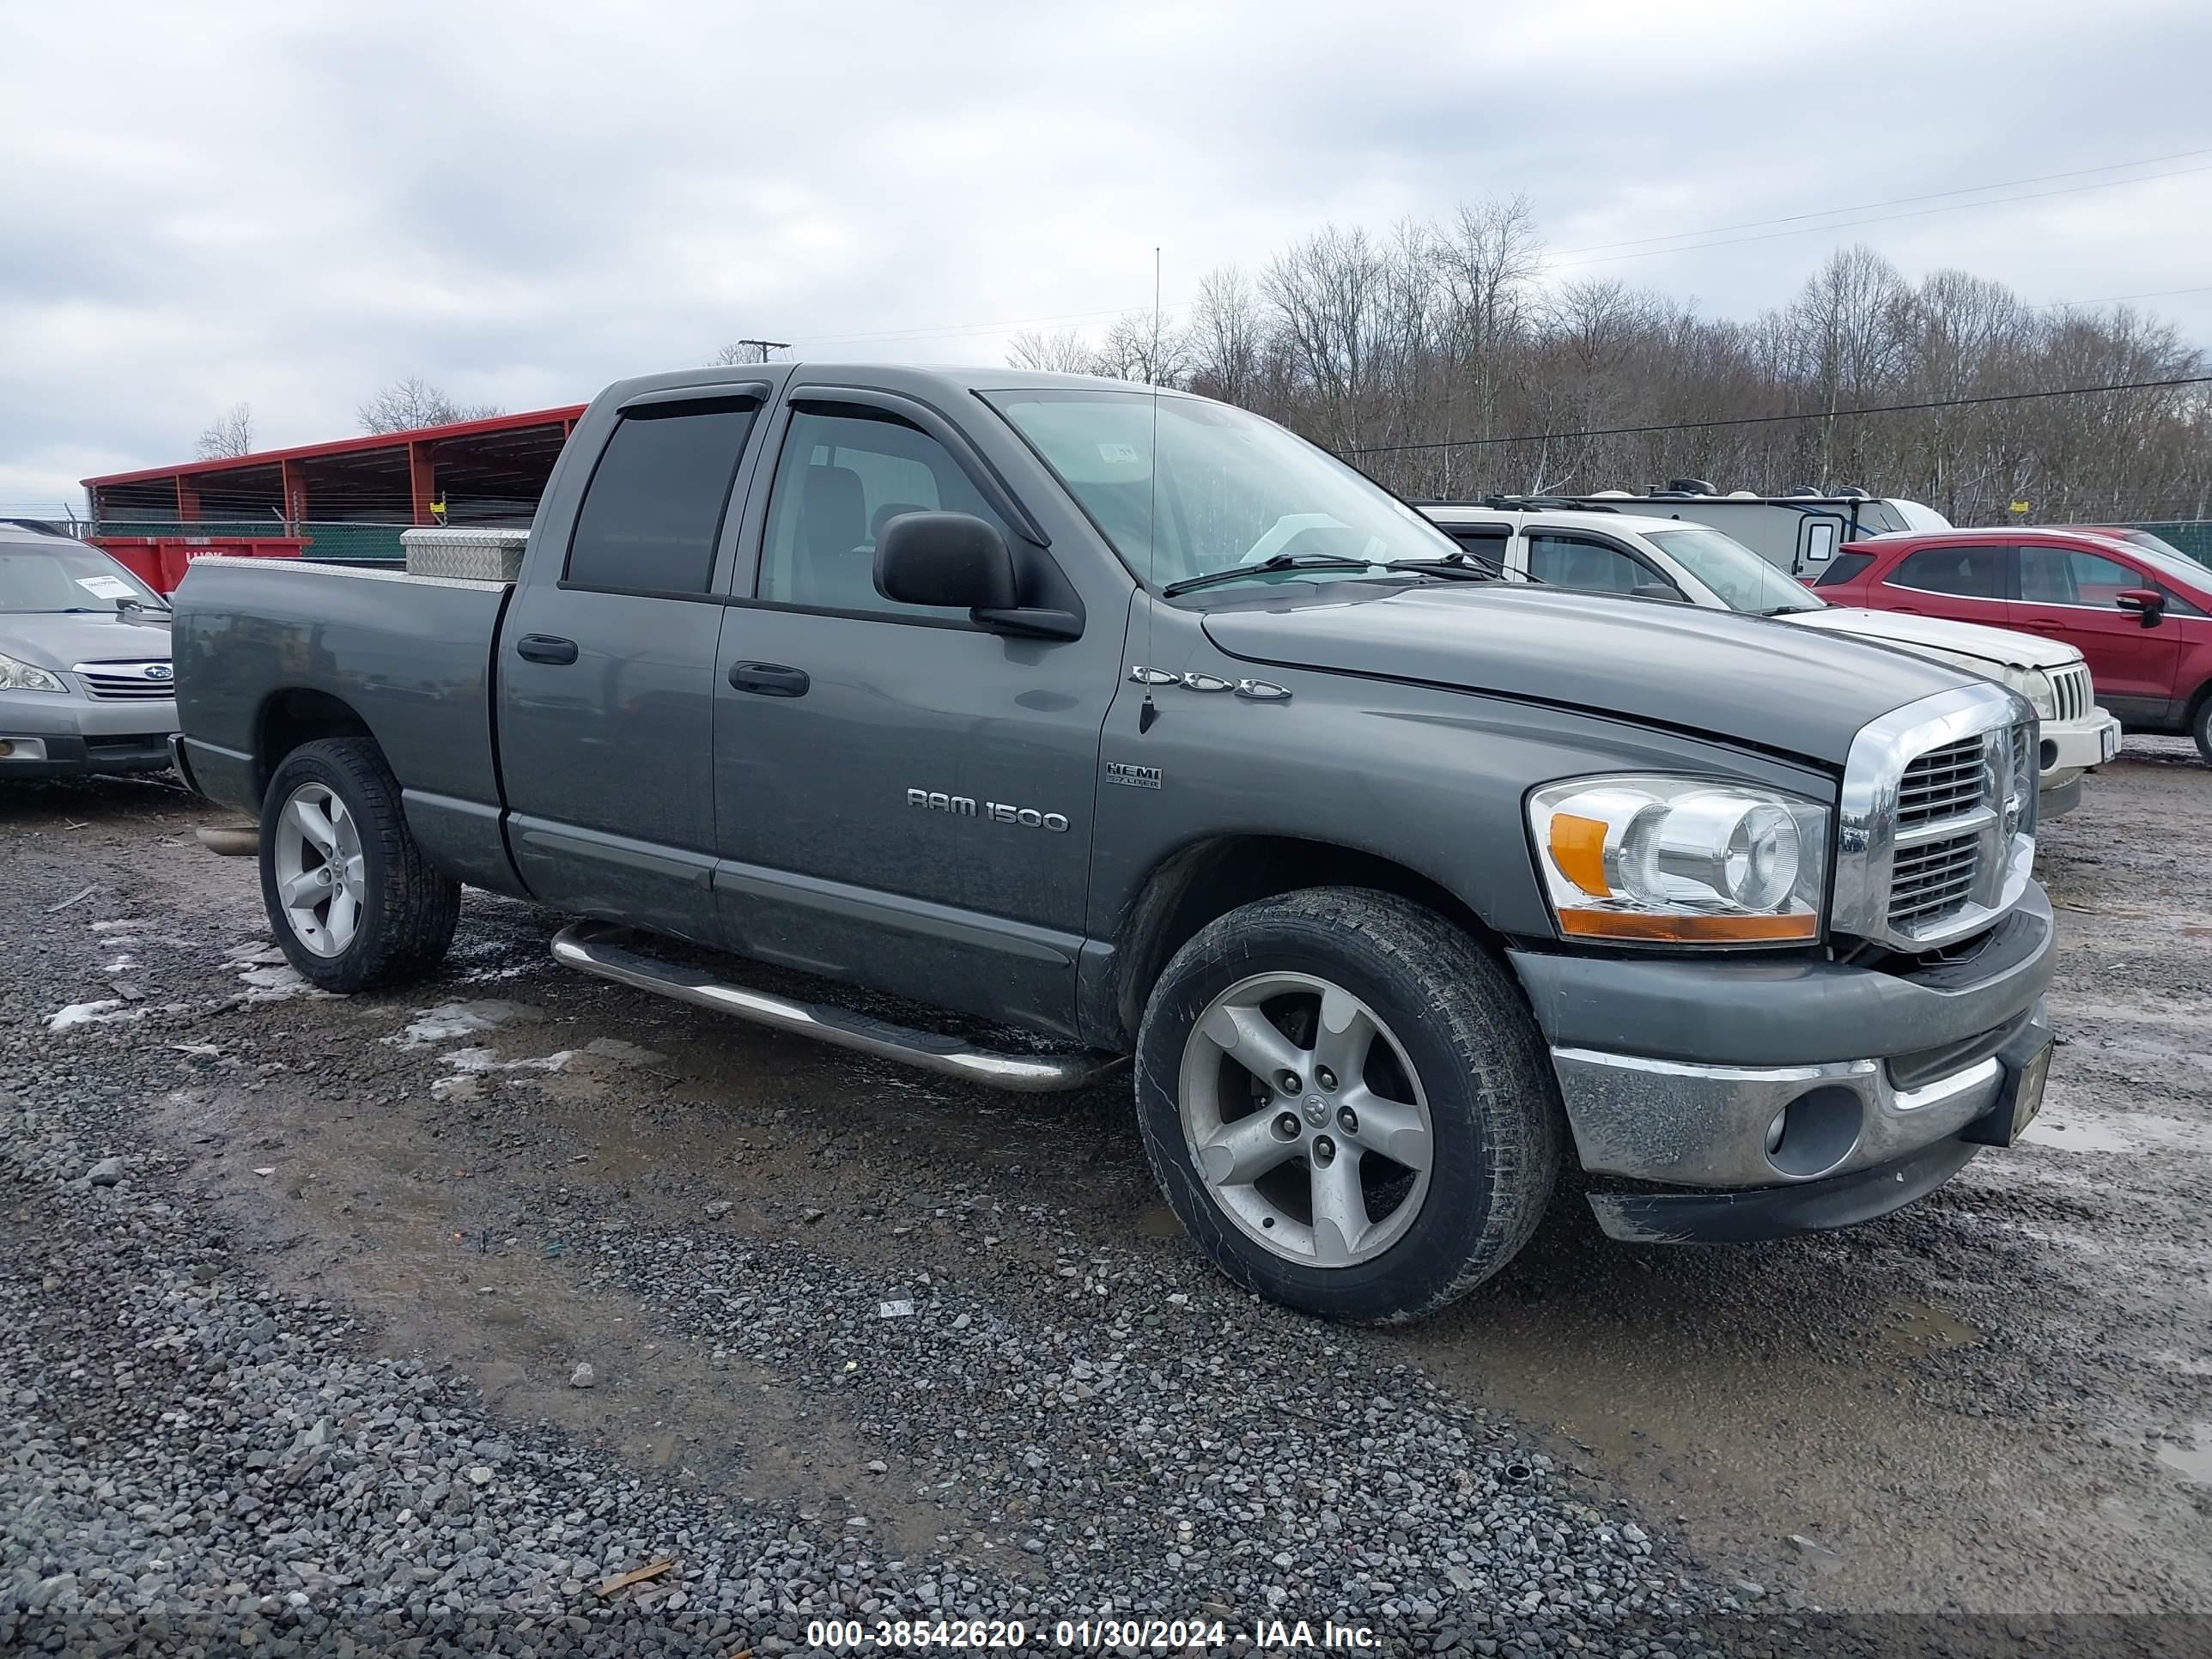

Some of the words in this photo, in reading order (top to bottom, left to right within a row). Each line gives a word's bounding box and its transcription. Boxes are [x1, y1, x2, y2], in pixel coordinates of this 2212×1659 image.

[1107, 763, 1159, 780] HEMI
[1127, 777, 1158, 787] LITER
[907, 787, 977, 817] RAM
[986, 802, 1070, 832] 1500
